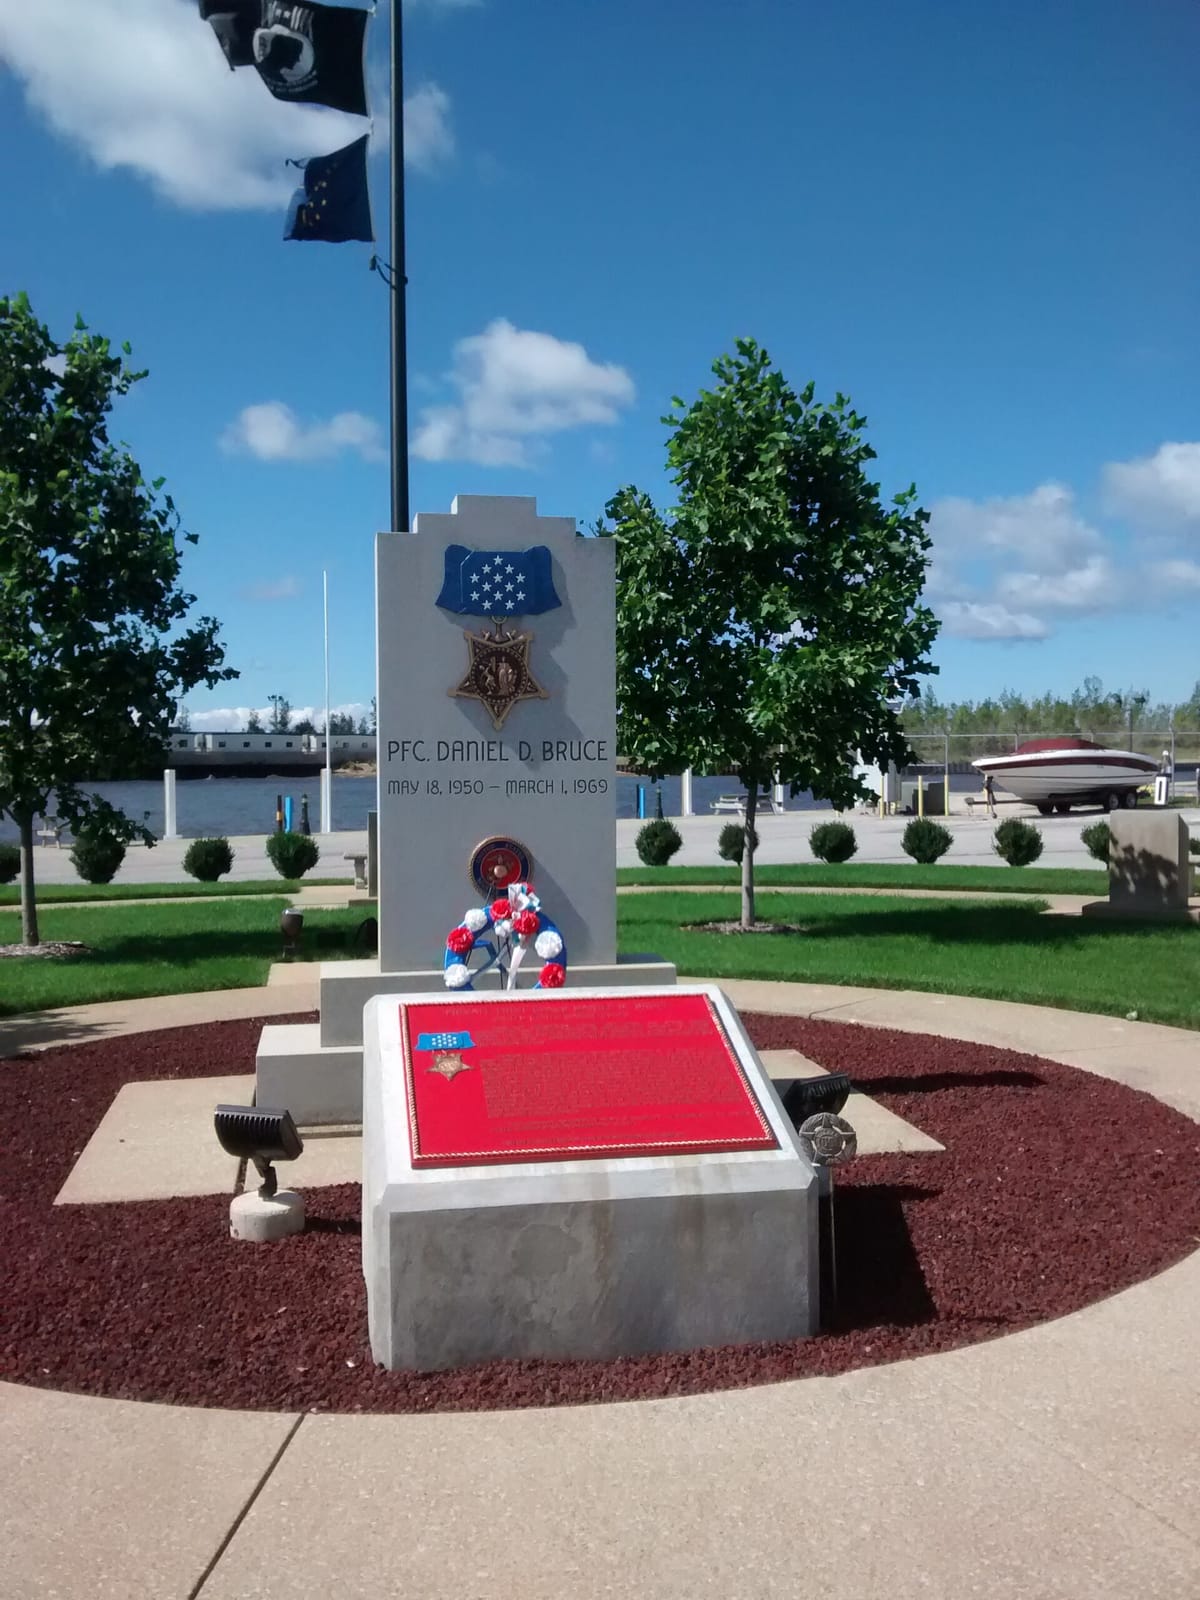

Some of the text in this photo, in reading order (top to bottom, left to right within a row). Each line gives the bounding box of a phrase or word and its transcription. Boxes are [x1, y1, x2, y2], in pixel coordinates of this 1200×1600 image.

[388, 739, 608, 762] PFC. DANIEL D. BRUCE
[388, 780, 419, 795] MAY
[448, 779, 484, 795] 1950
[505, 779, 554, 795] MARCH
[573, 779, 608, 794] 1969
